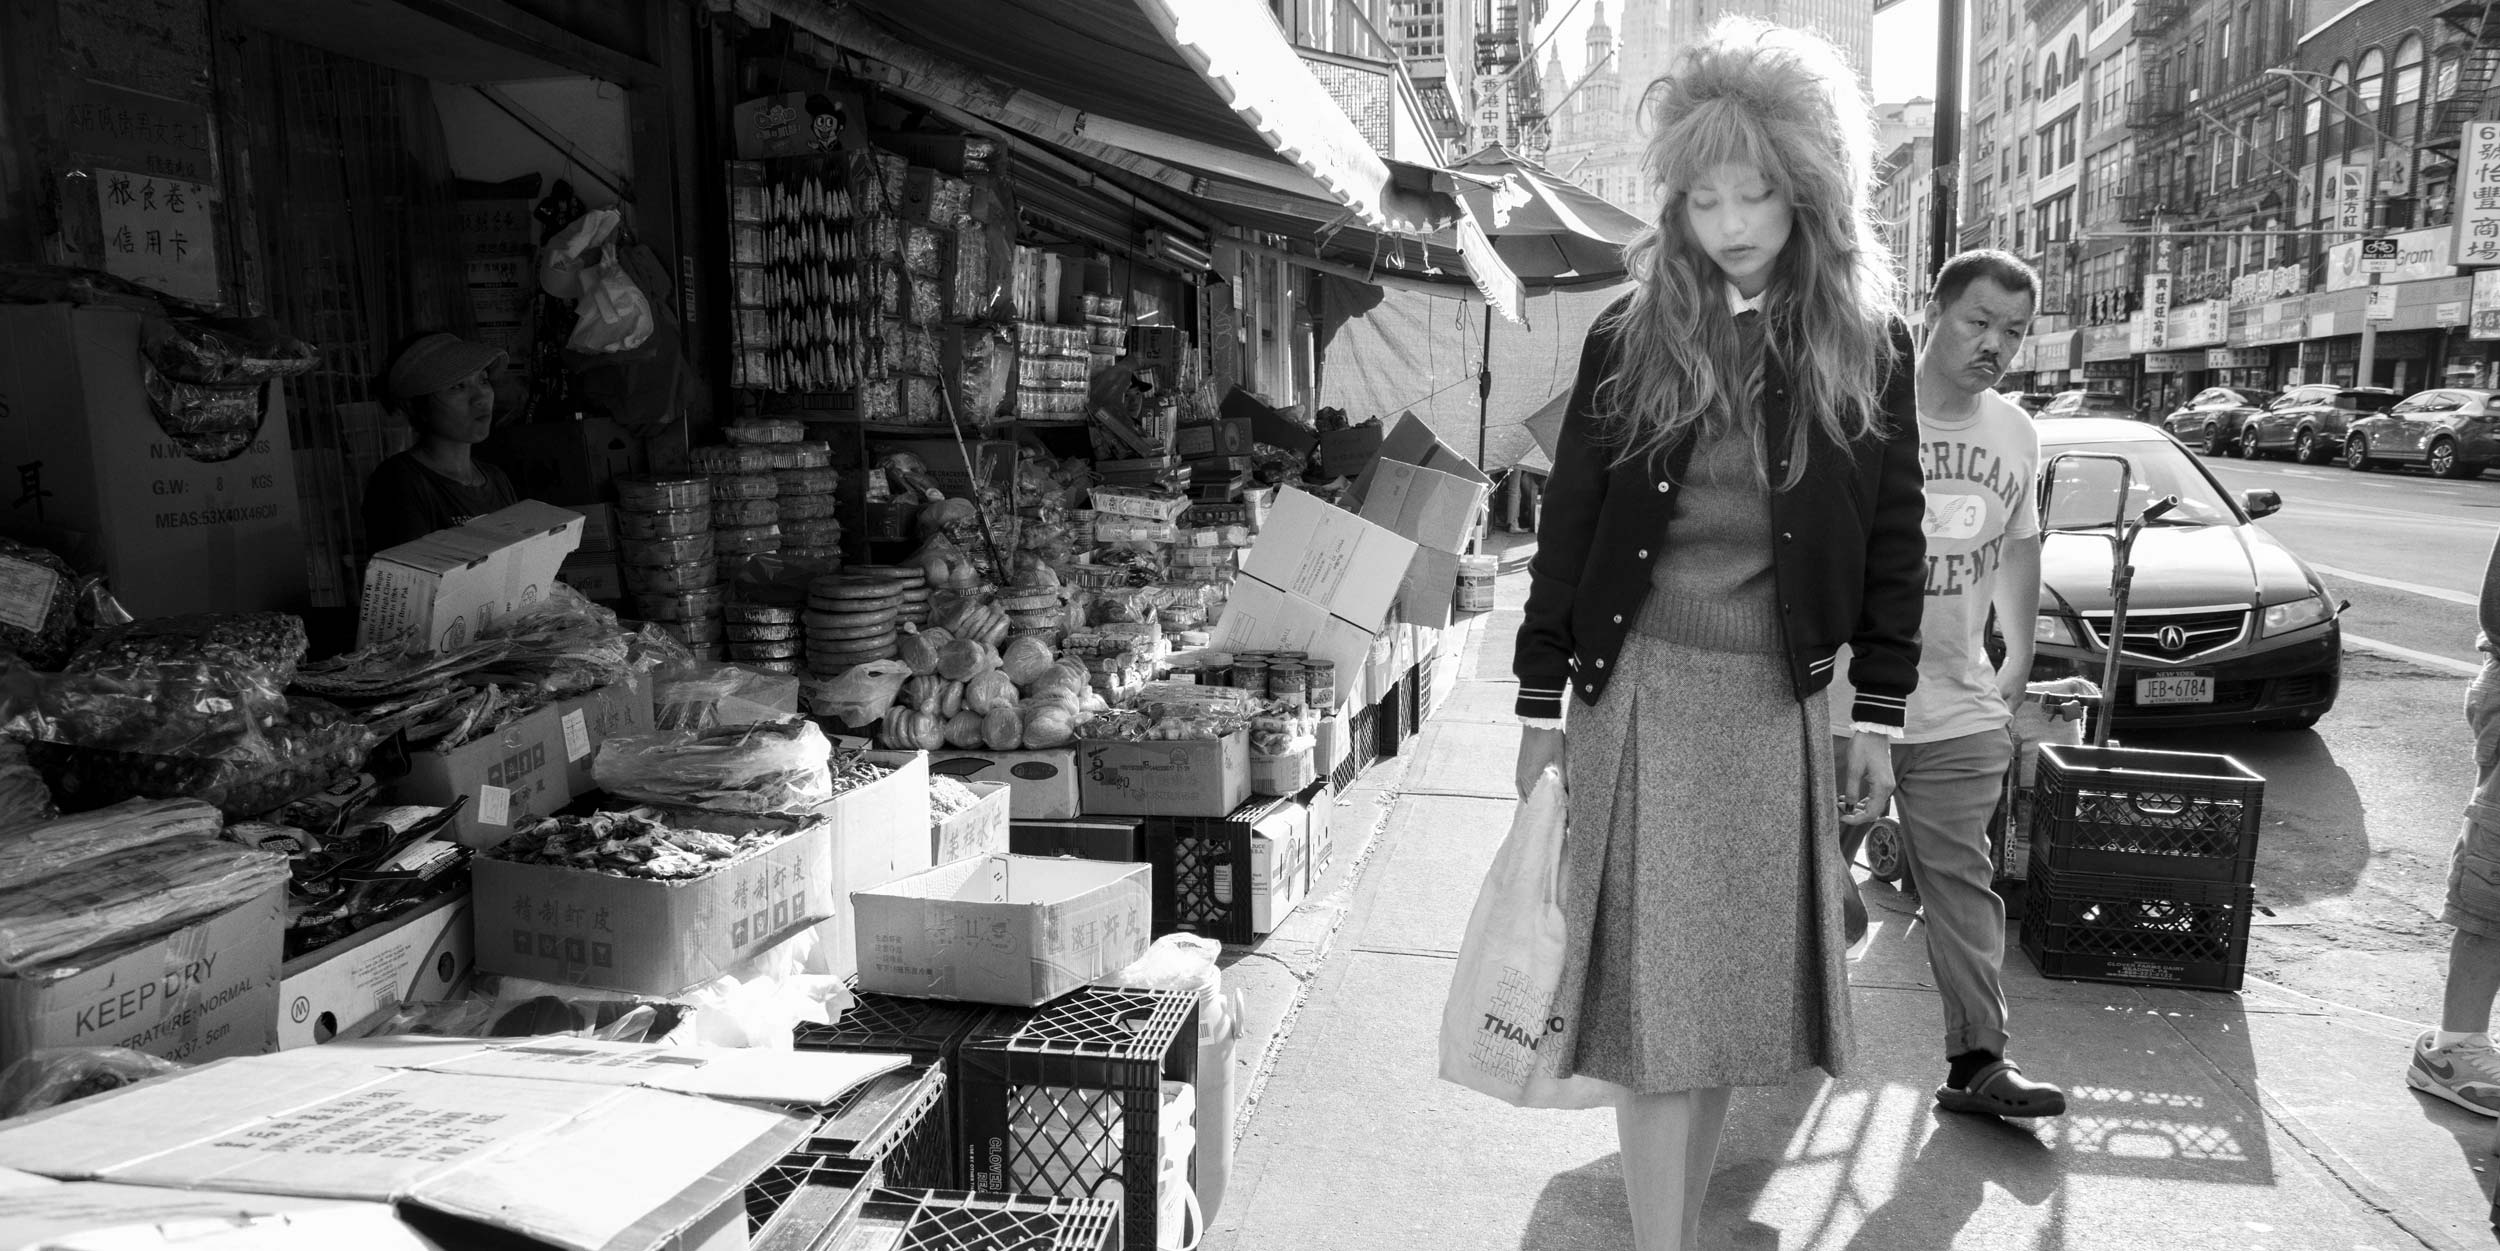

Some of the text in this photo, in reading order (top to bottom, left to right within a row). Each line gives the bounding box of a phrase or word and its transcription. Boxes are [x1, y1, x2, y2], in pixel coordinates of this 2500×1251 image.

[2480, 127, 2500, 140] 6
[112, 225, 188, 262] 信用卡
[251, 473, 273, 490] KGS
[1964, 506, 1977, 528] 3
[512, 895, 613, 933] 精制虾皮
[76, 952, 217, 1038] KEEP DRY
[199, 978, 254, 1018] NORMAL
[1485, 1013, 1539, 1051] THAN
[988, 1137, 1003, 1191] CLOVER
